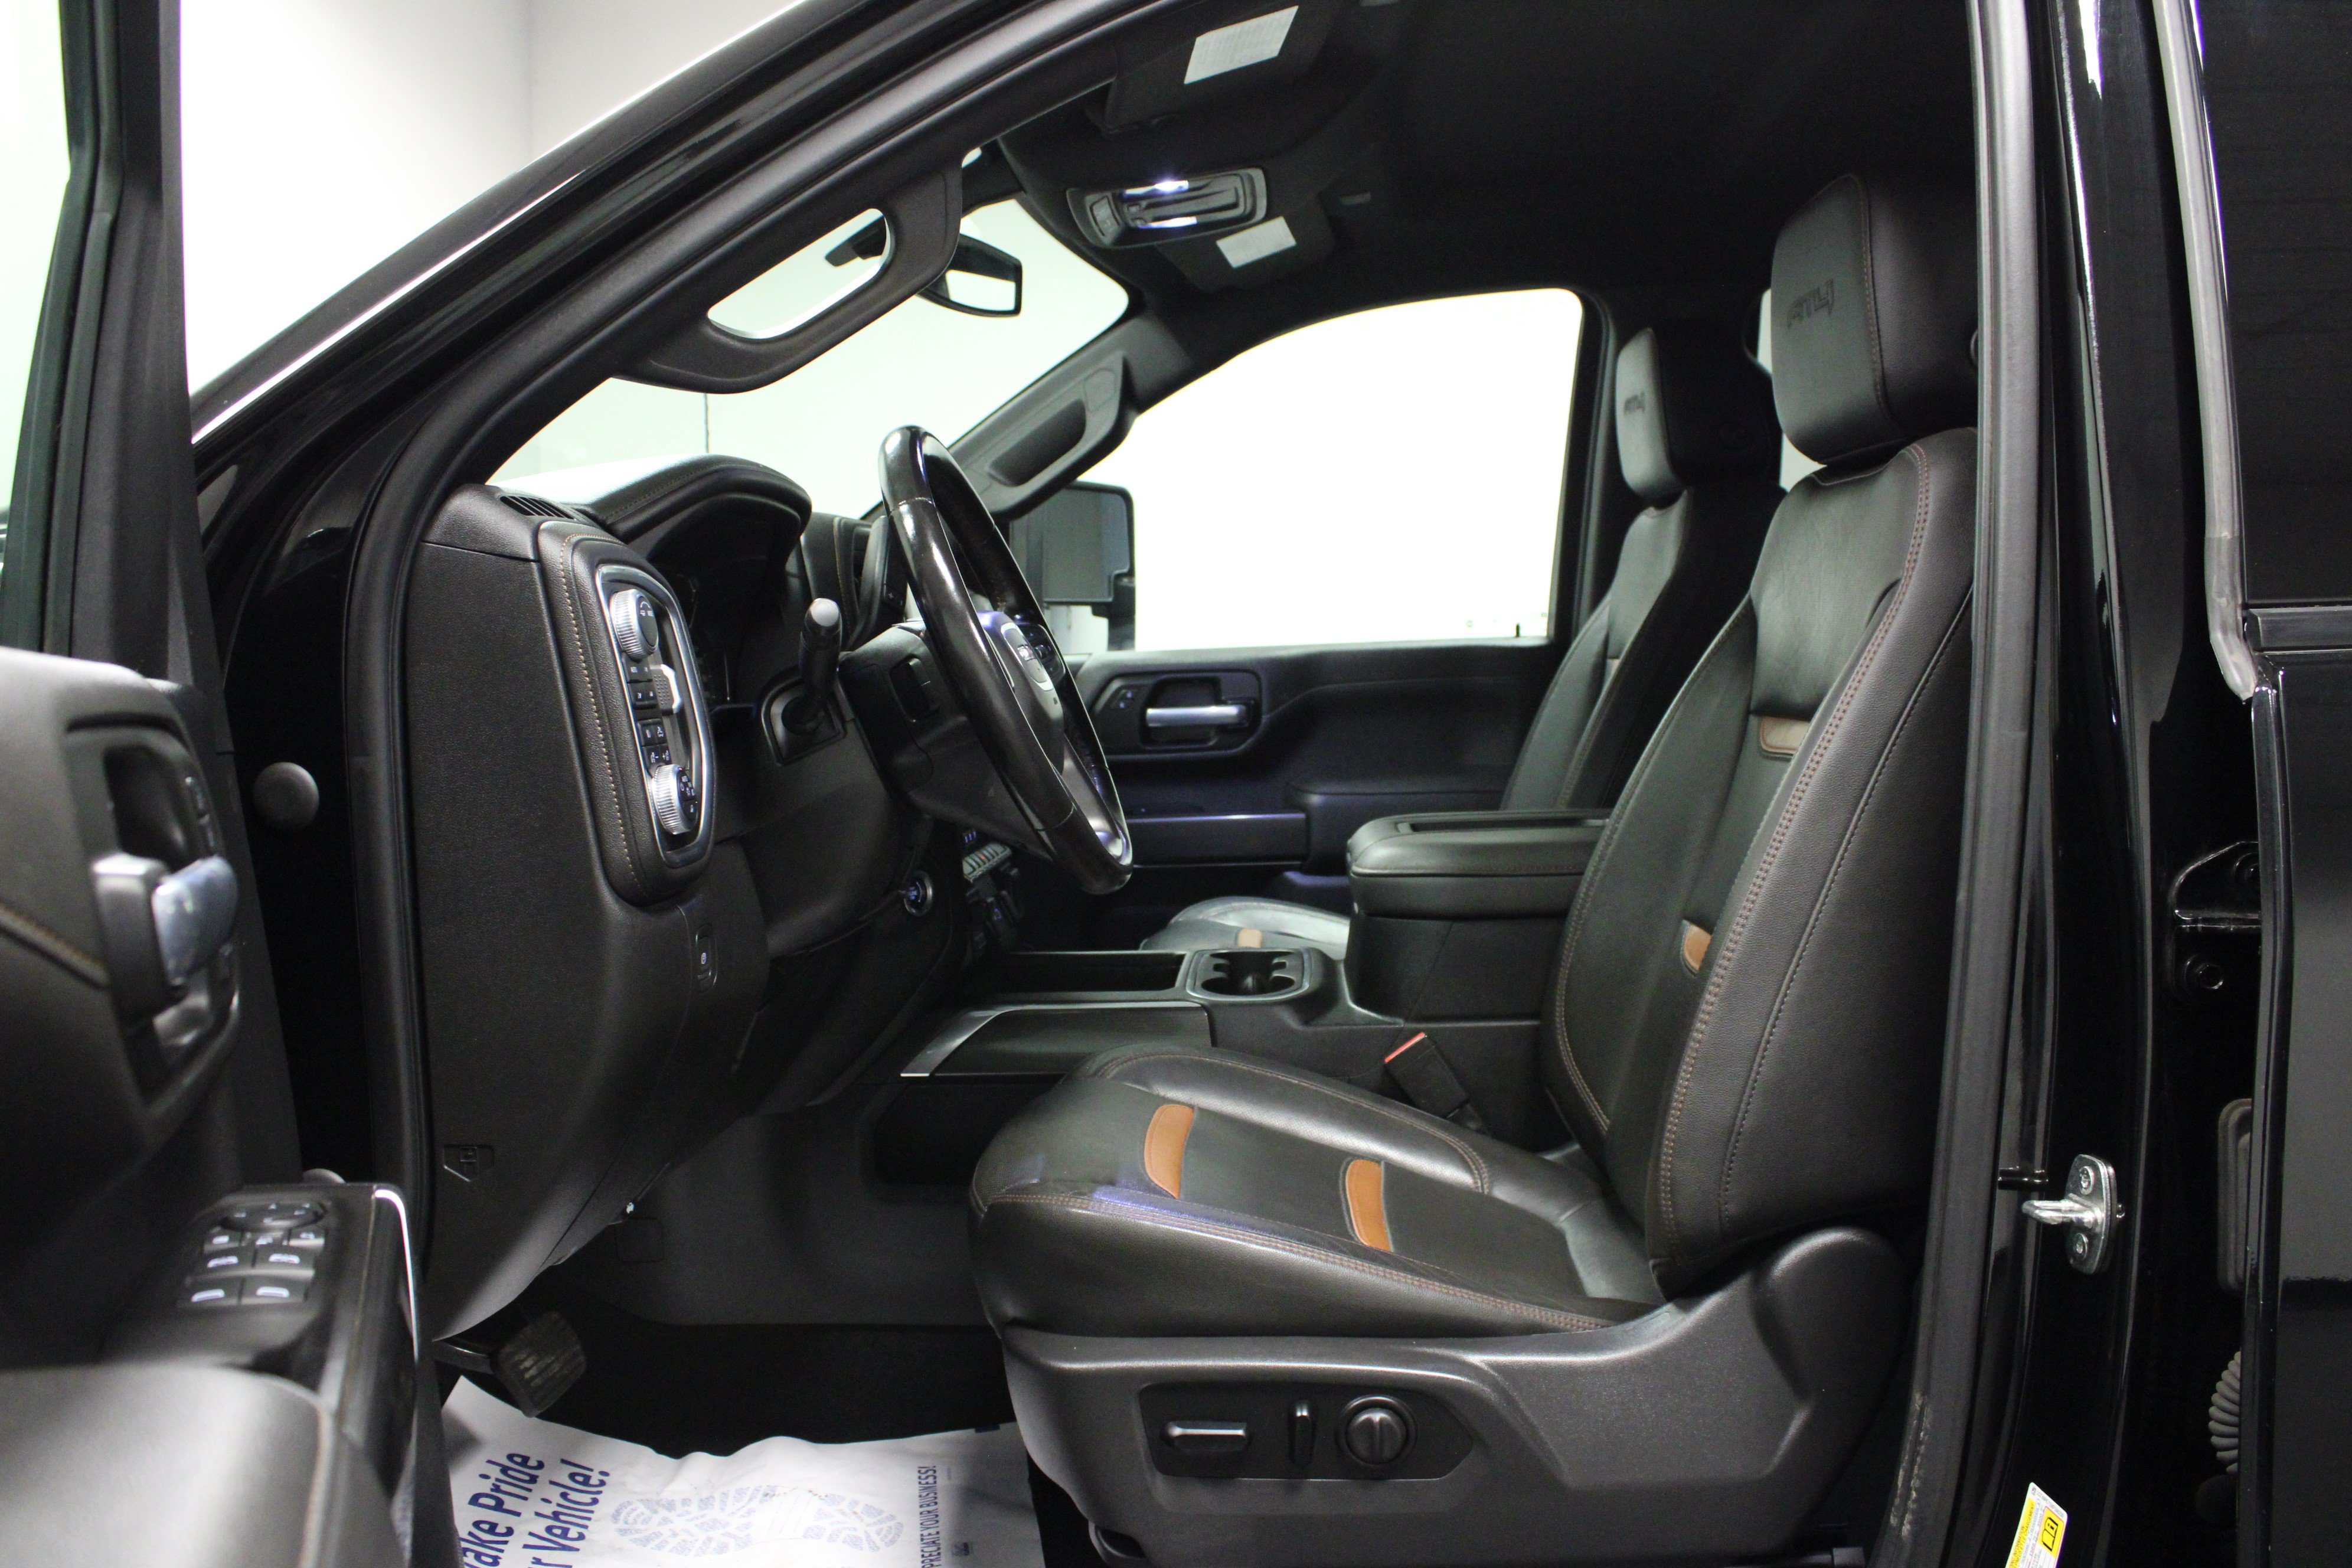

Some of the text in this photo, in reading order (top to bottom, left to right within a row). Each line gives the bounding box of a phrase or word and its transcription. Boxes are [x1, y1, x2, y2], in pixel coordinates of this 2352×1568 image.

[459, 1453, 545, 1568] ake Pride
[522, 1458, 610, 1551] Vehicle!
[917, 1465, 937, 1508] BUSINESS!
[920, 1508, 939, 1531] YOUR
